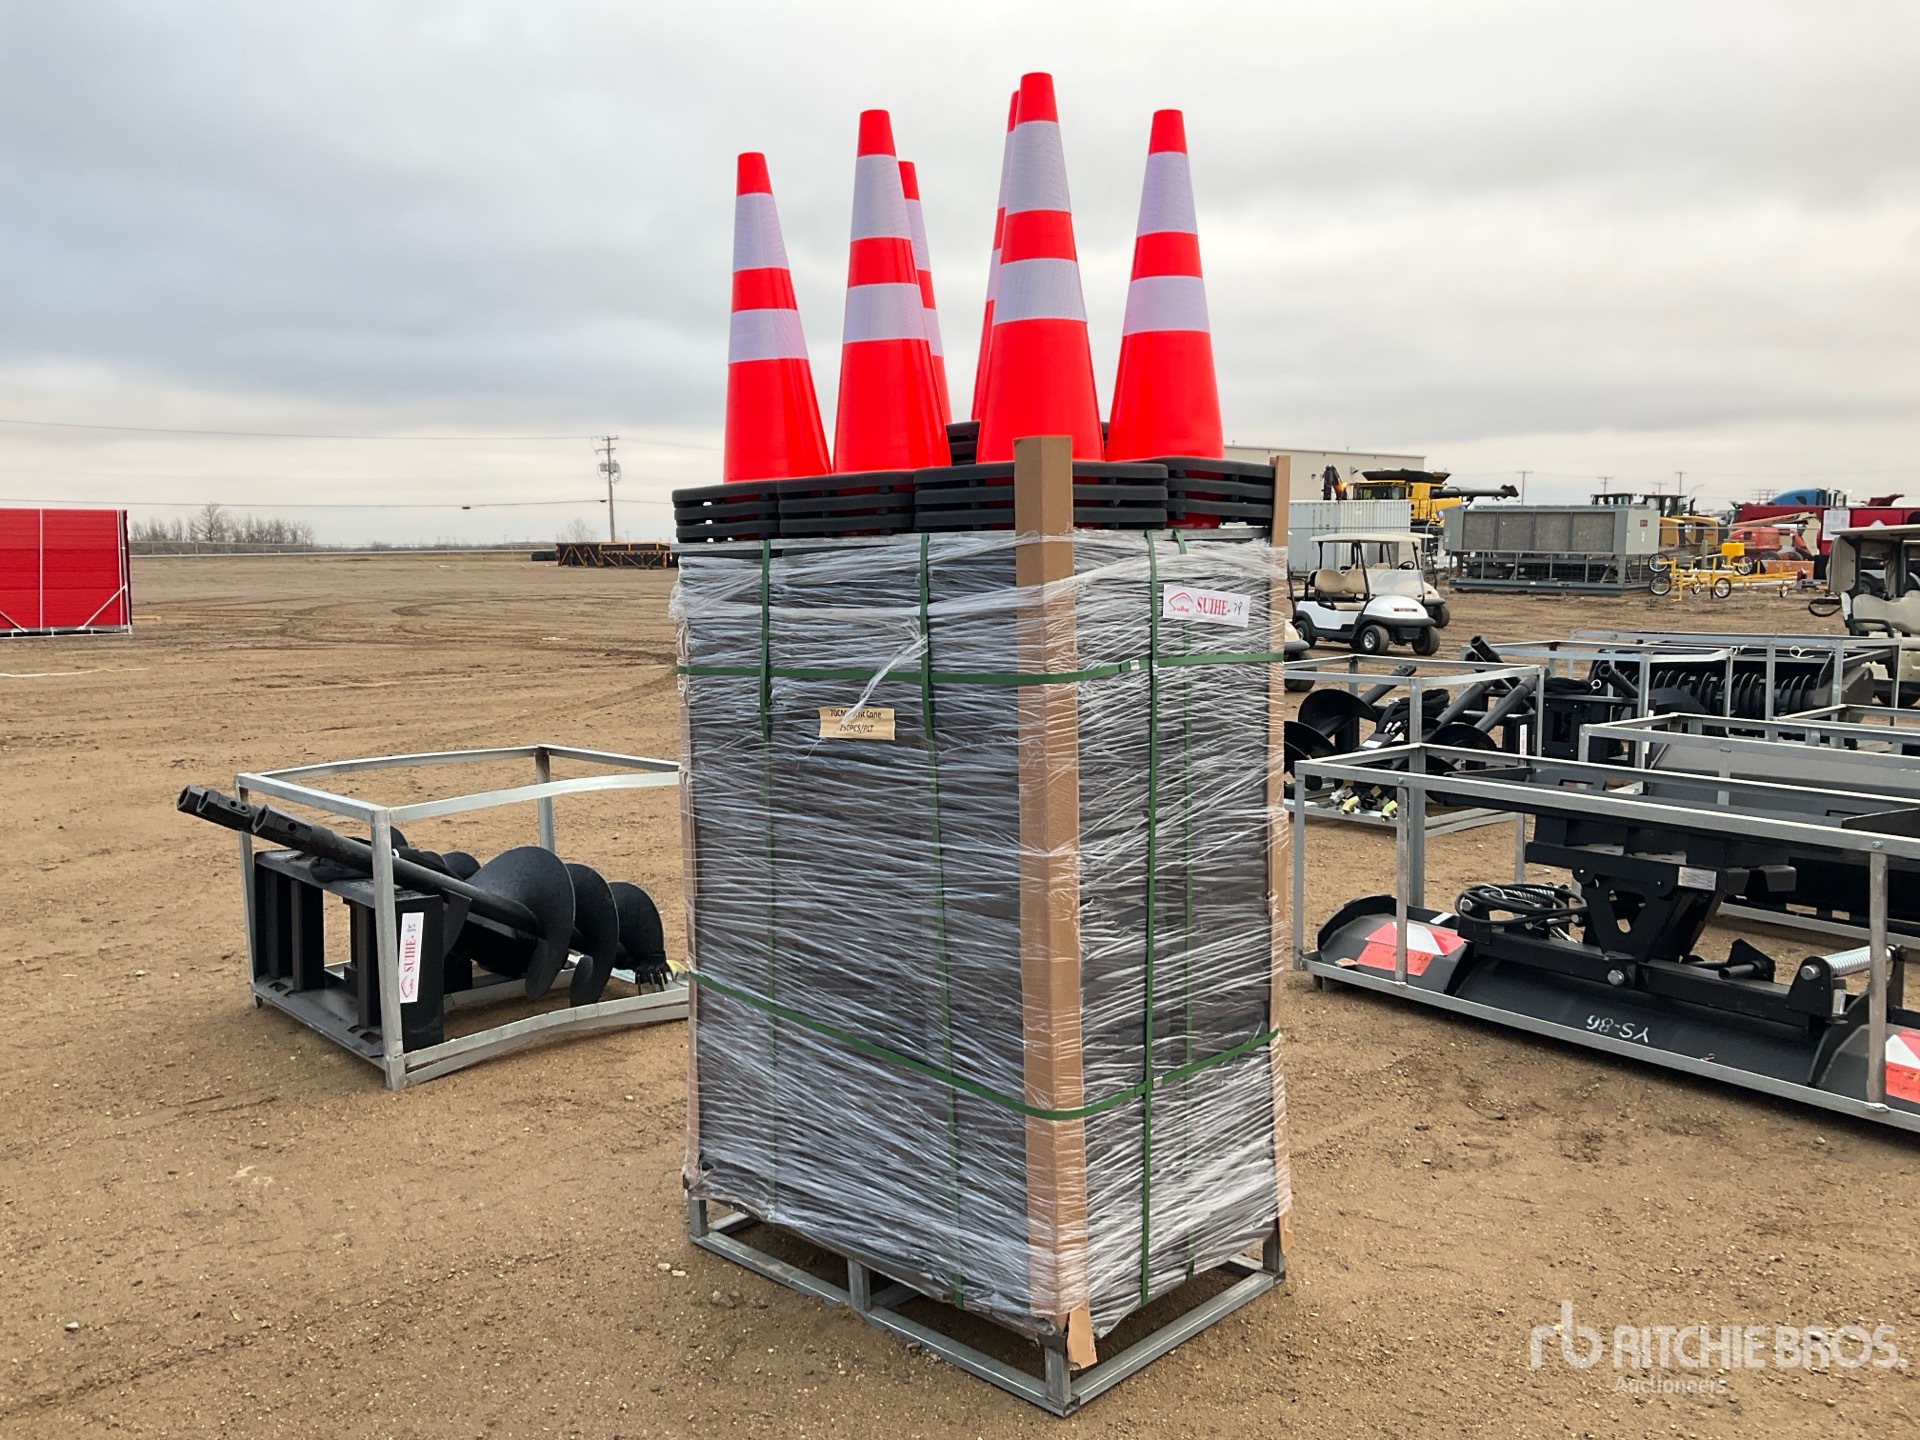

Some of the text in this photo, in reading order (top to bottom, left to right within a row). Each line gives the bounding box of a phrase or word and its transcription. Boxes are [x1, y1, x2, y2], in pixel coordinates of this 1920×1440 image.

[1196, 597, 1229, 616] SUIHE
[866, 710, 882, 719] Cone
[403, 939, 416, 972] SUIHE
